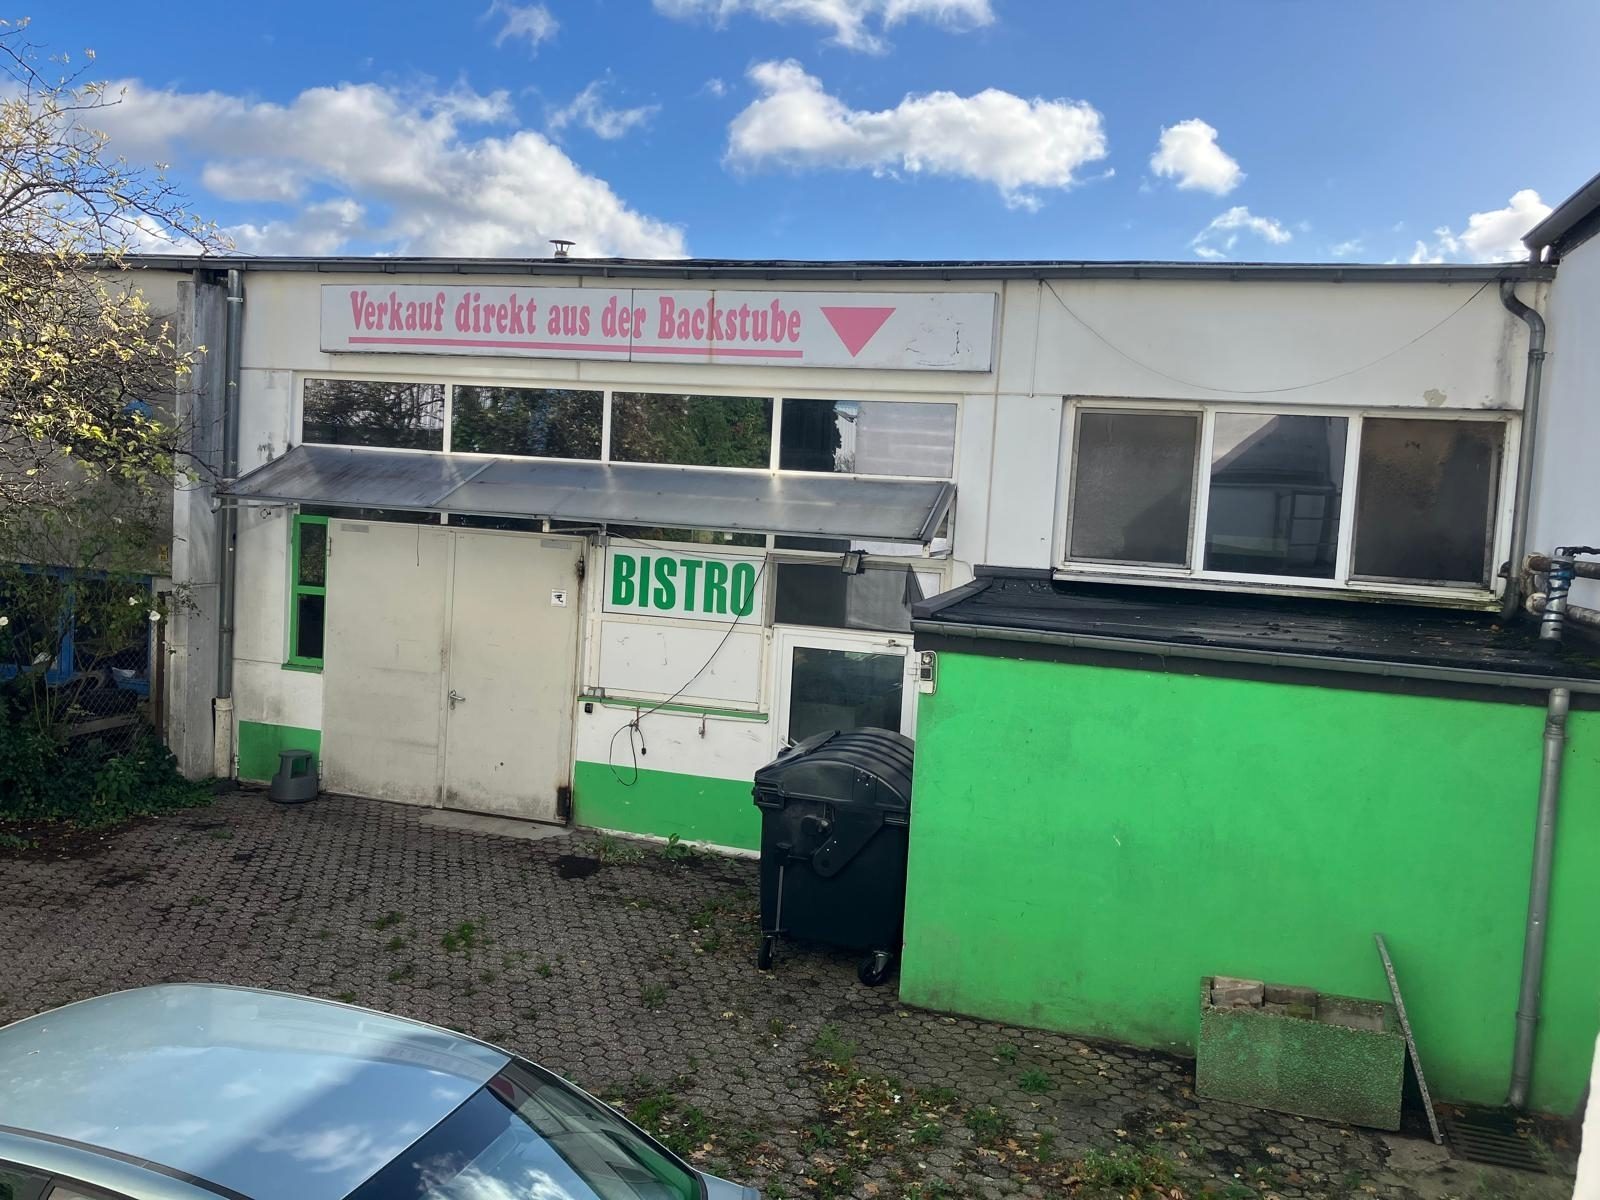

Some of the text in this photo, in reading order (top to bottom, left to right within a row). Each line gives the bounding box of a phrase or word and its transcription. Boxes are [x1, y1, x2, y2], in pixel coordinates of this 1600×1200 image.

[350, 290, 801, 343] Verkauf direkt aus der Backstube
[611, 554, 756, 617] BISTRO
